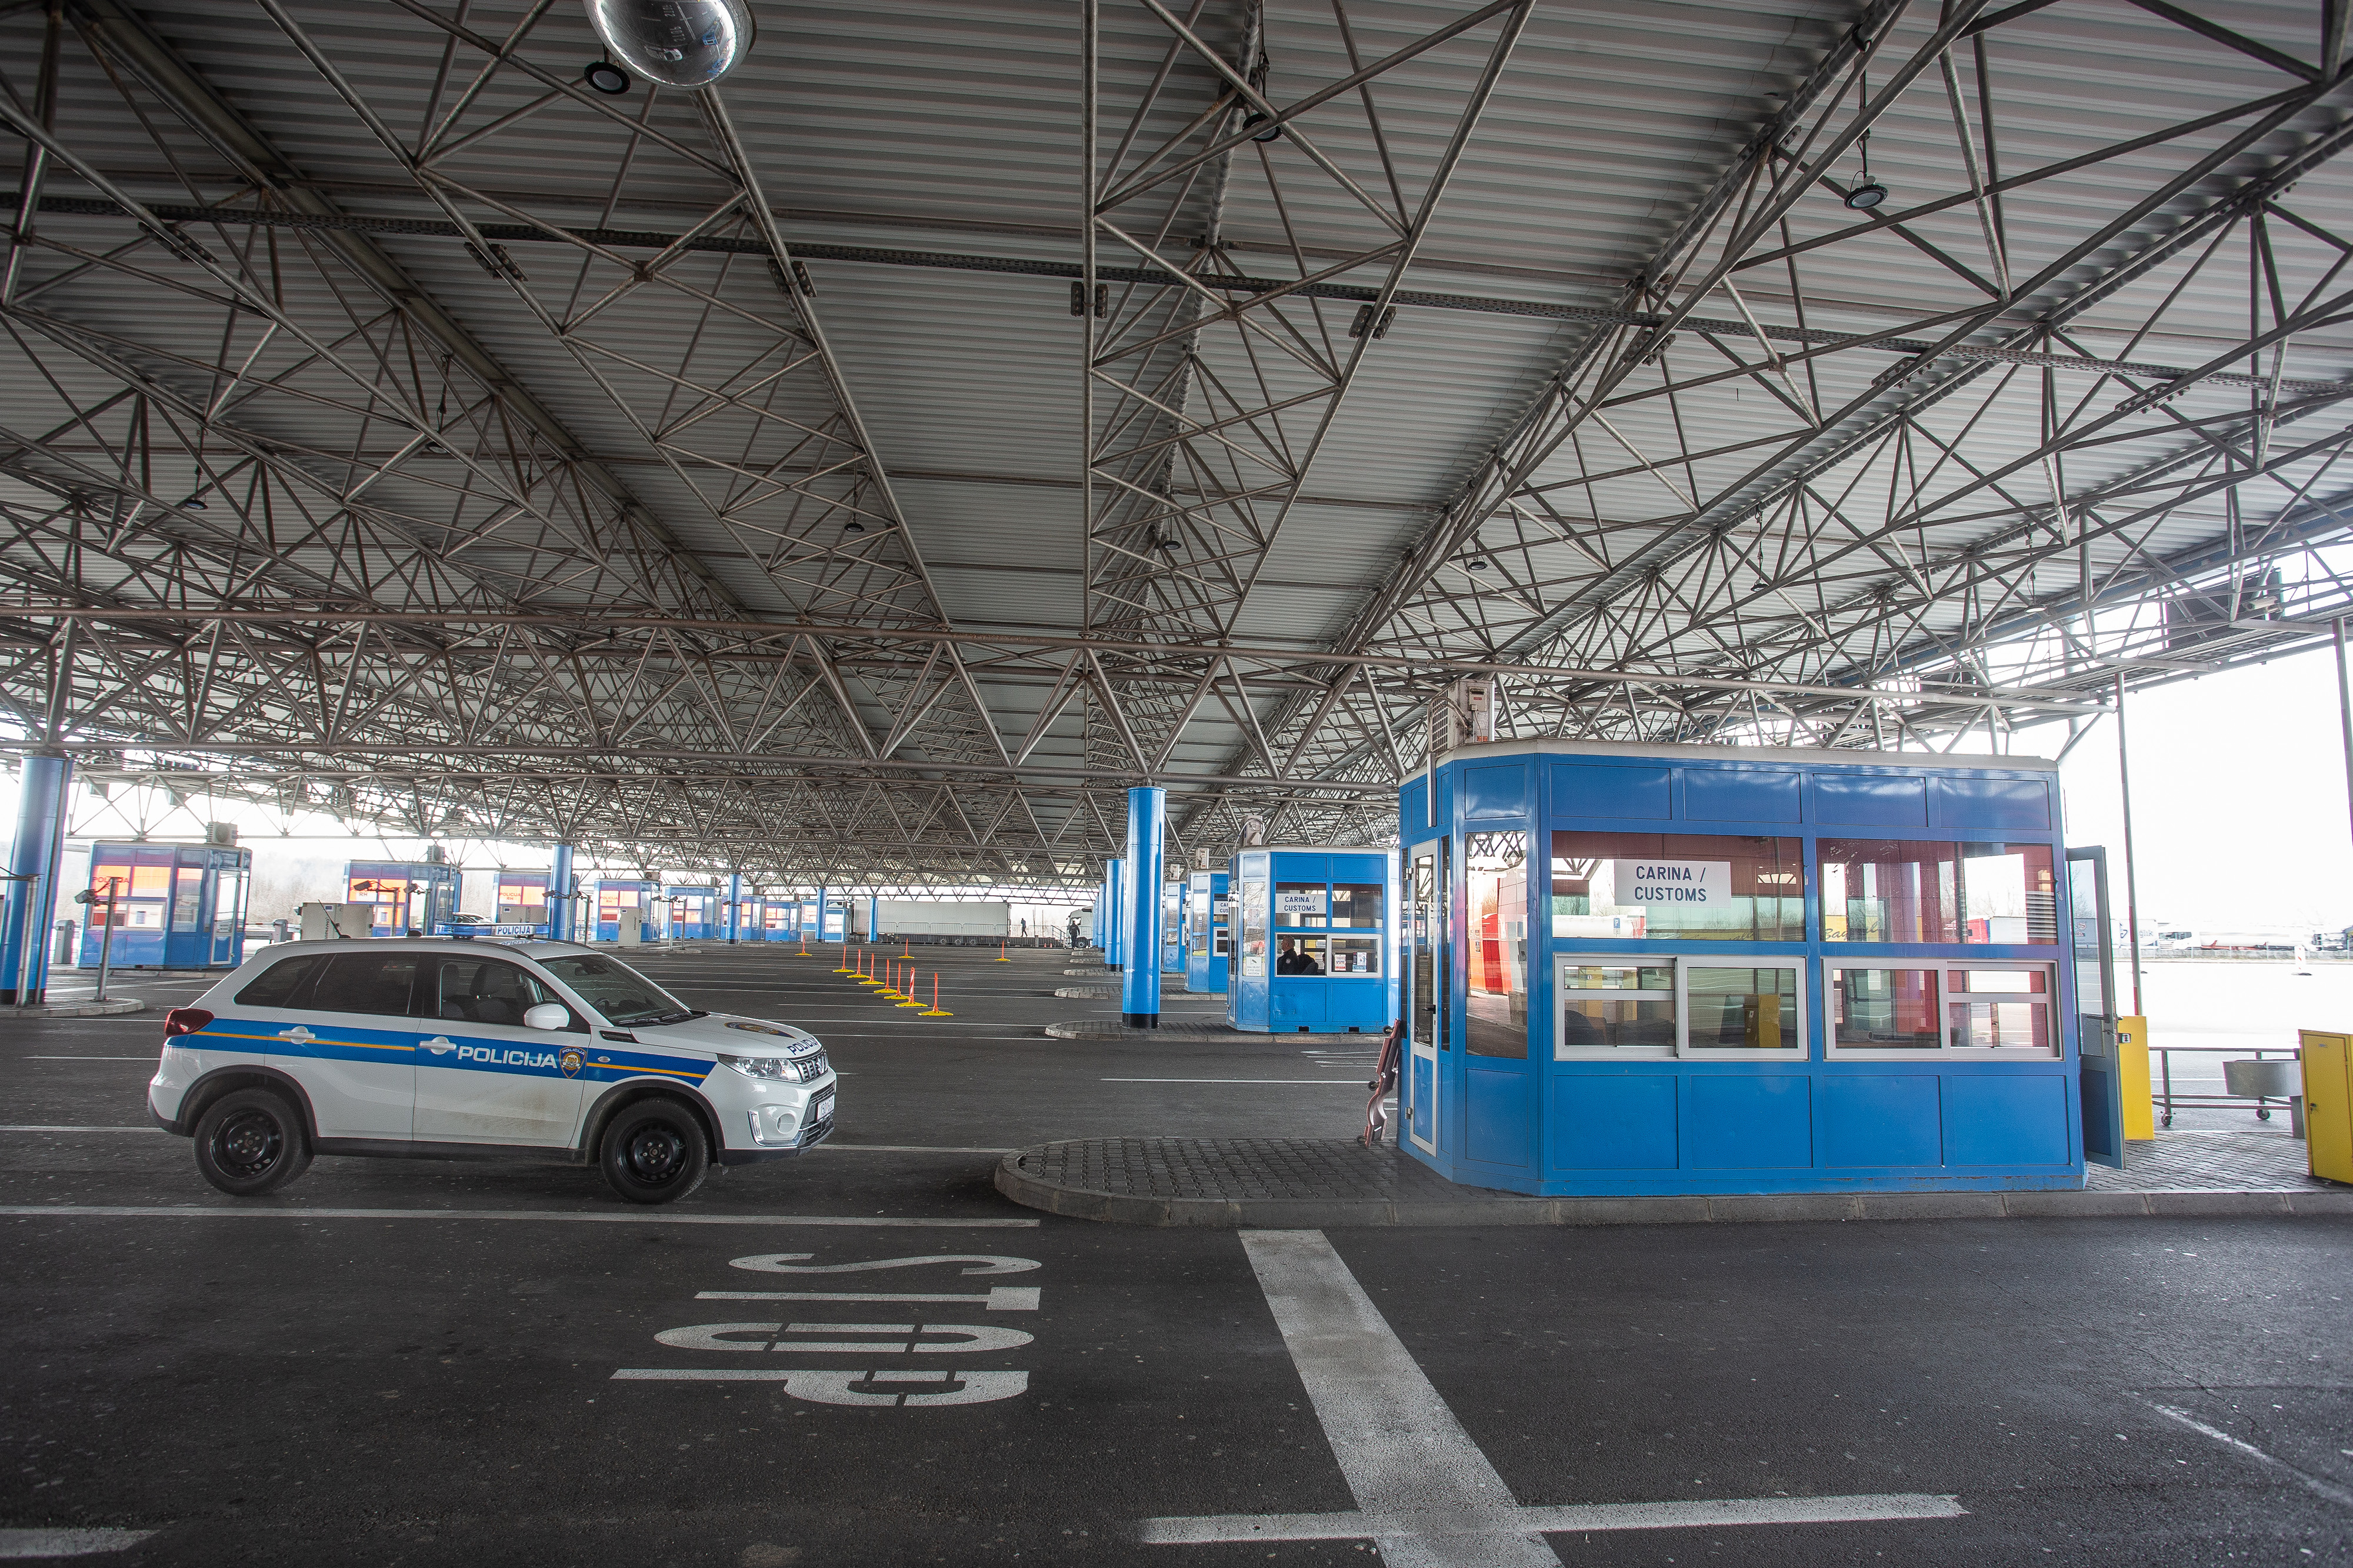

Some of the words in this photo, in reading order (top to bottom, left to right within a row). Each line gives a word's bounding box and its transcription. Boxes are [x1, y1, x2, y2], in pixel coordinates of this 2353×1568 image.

[1636, 866, 1692, 881] CARINA
[1699, 867, 1706, 882] /
[1635, 886, 1707, 902] CUSTOMS
[498, 926, 530, 935] POLICIJA
[787, 1037, 818, 1055] POLICIJ
[458, 1046, 557, 1069] POLICIJA
[609, 1253, 1042, 1406] STOP
